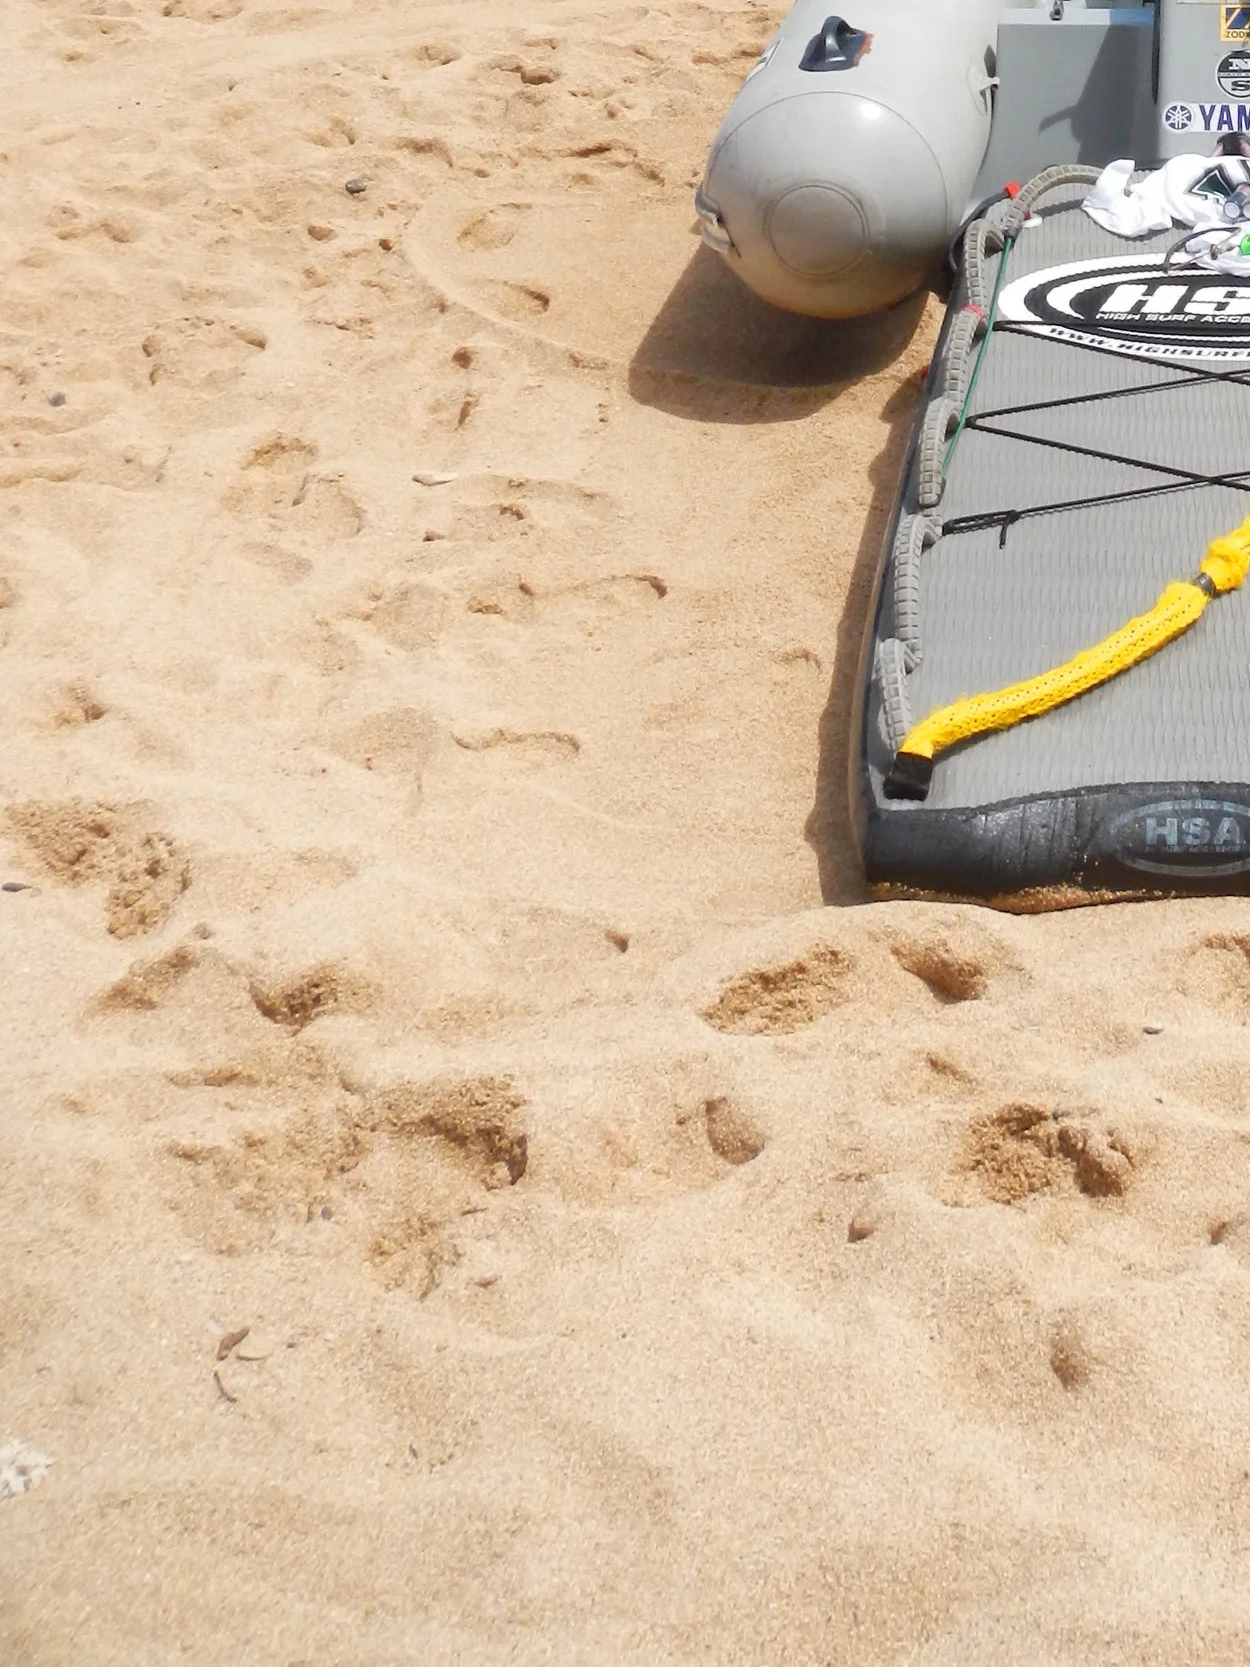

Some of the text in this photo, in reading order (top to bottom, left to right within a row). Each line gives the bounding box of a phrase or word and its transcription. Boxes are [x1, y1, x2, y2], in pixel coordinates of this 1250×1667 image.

[1095, 312, 1140, 322] HIGH
[1145, 313, 1197, 323] SURF
[1145, 817, 1245, 845] HSA
